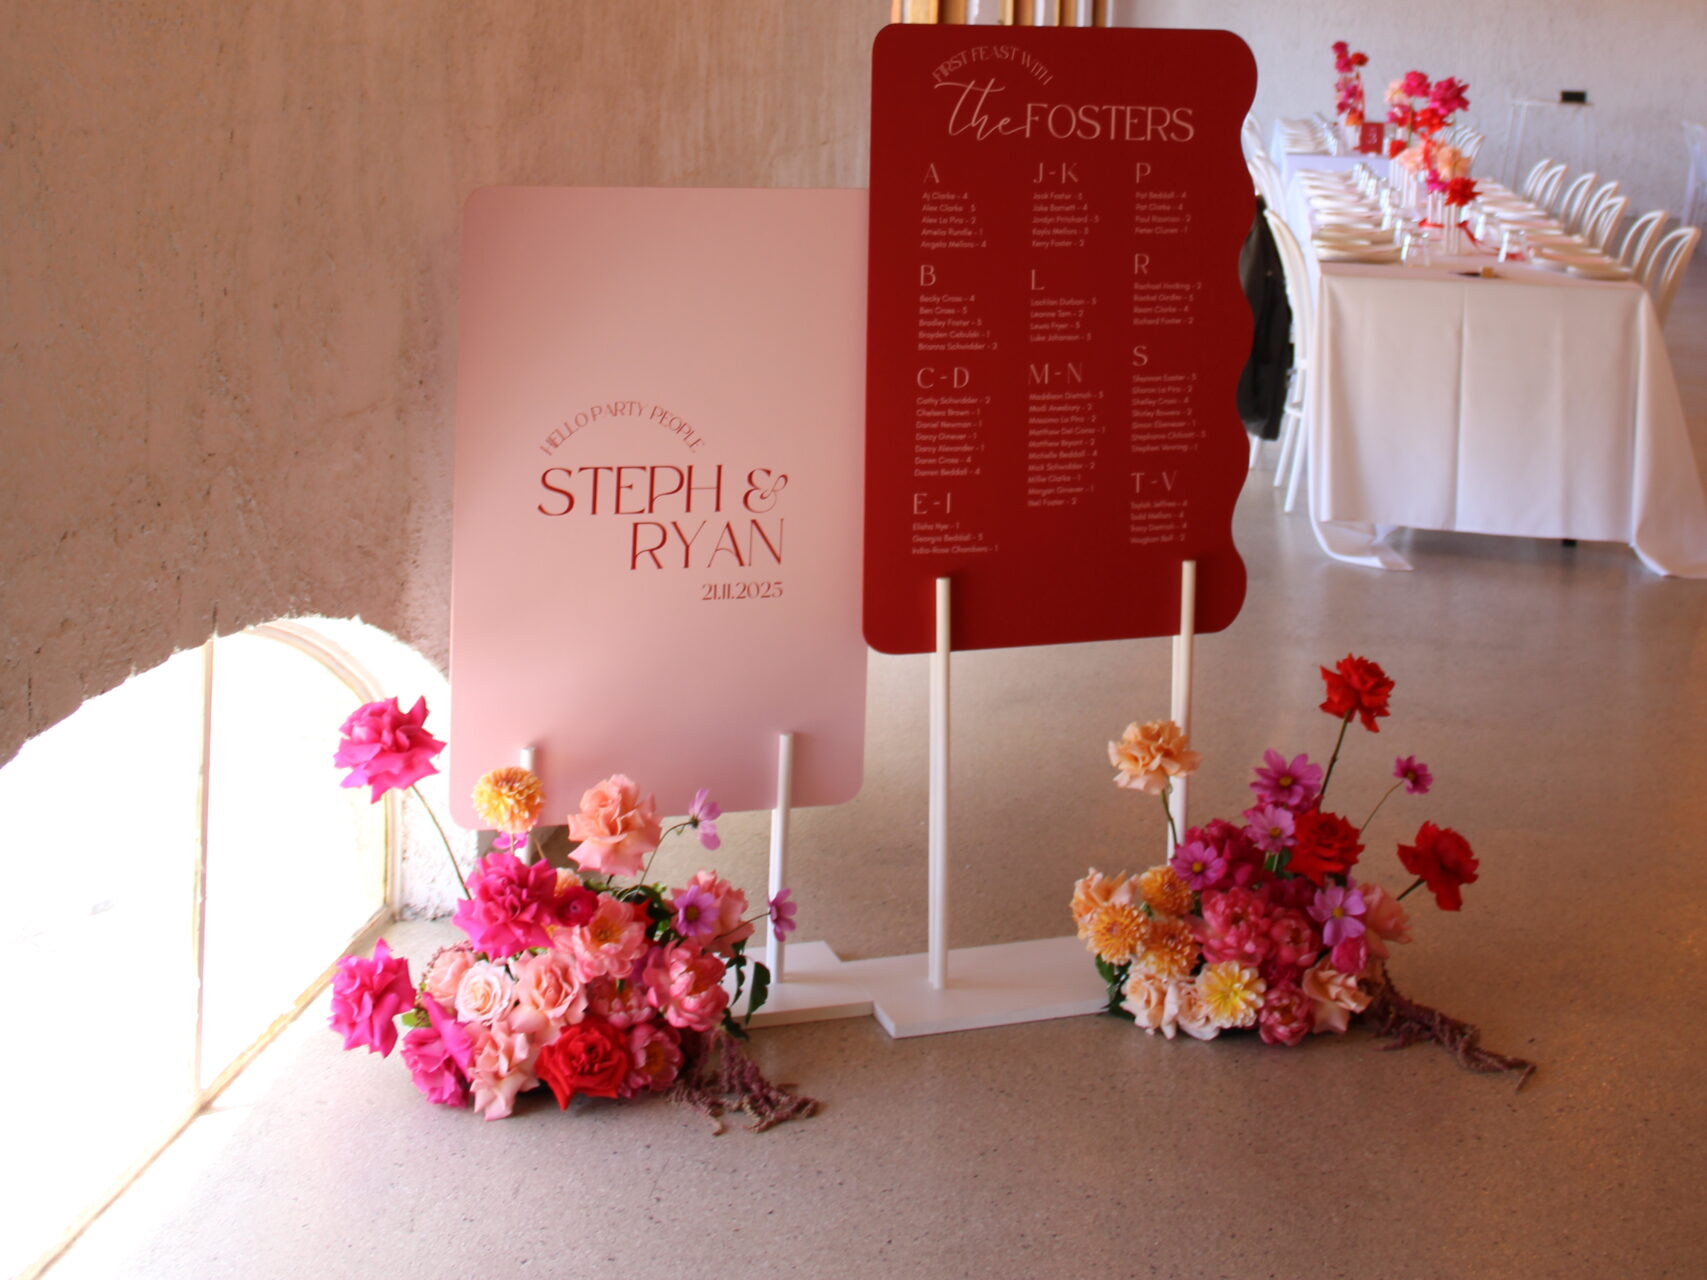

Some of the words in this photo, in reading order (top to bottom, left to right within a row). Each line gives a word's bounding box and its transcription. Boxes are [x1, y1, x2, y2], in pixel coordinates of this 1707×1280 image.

[932, 51, 968, 82] FIRST
[972, 46, 1018, 62] FEAST
[1022, 51, 1053, 86] WITH
[934, 78, 1028, 140] the
[1025, 103, 1194, 142] FOSTERS
[923, 162, 940, 184] A
[1136, 162, 1151, 184] P
[920, 264, 936, 286] B
[1134, 253, 1150, 275] R
[1032, 269, 1045, 290] L
[1132, 345, 1148, 366] S
[540, 412, 588, 456] HELLO
[590, 401, 645, 421] PARTY
[650, 405, 705, 453] PEOPLE
[538, 464, 722, 516] STEPH
[743, 468, 788, 513] &
[631, 518, 784, 570] RYAN
[702, 582, 783, 600] 21.11.2025
